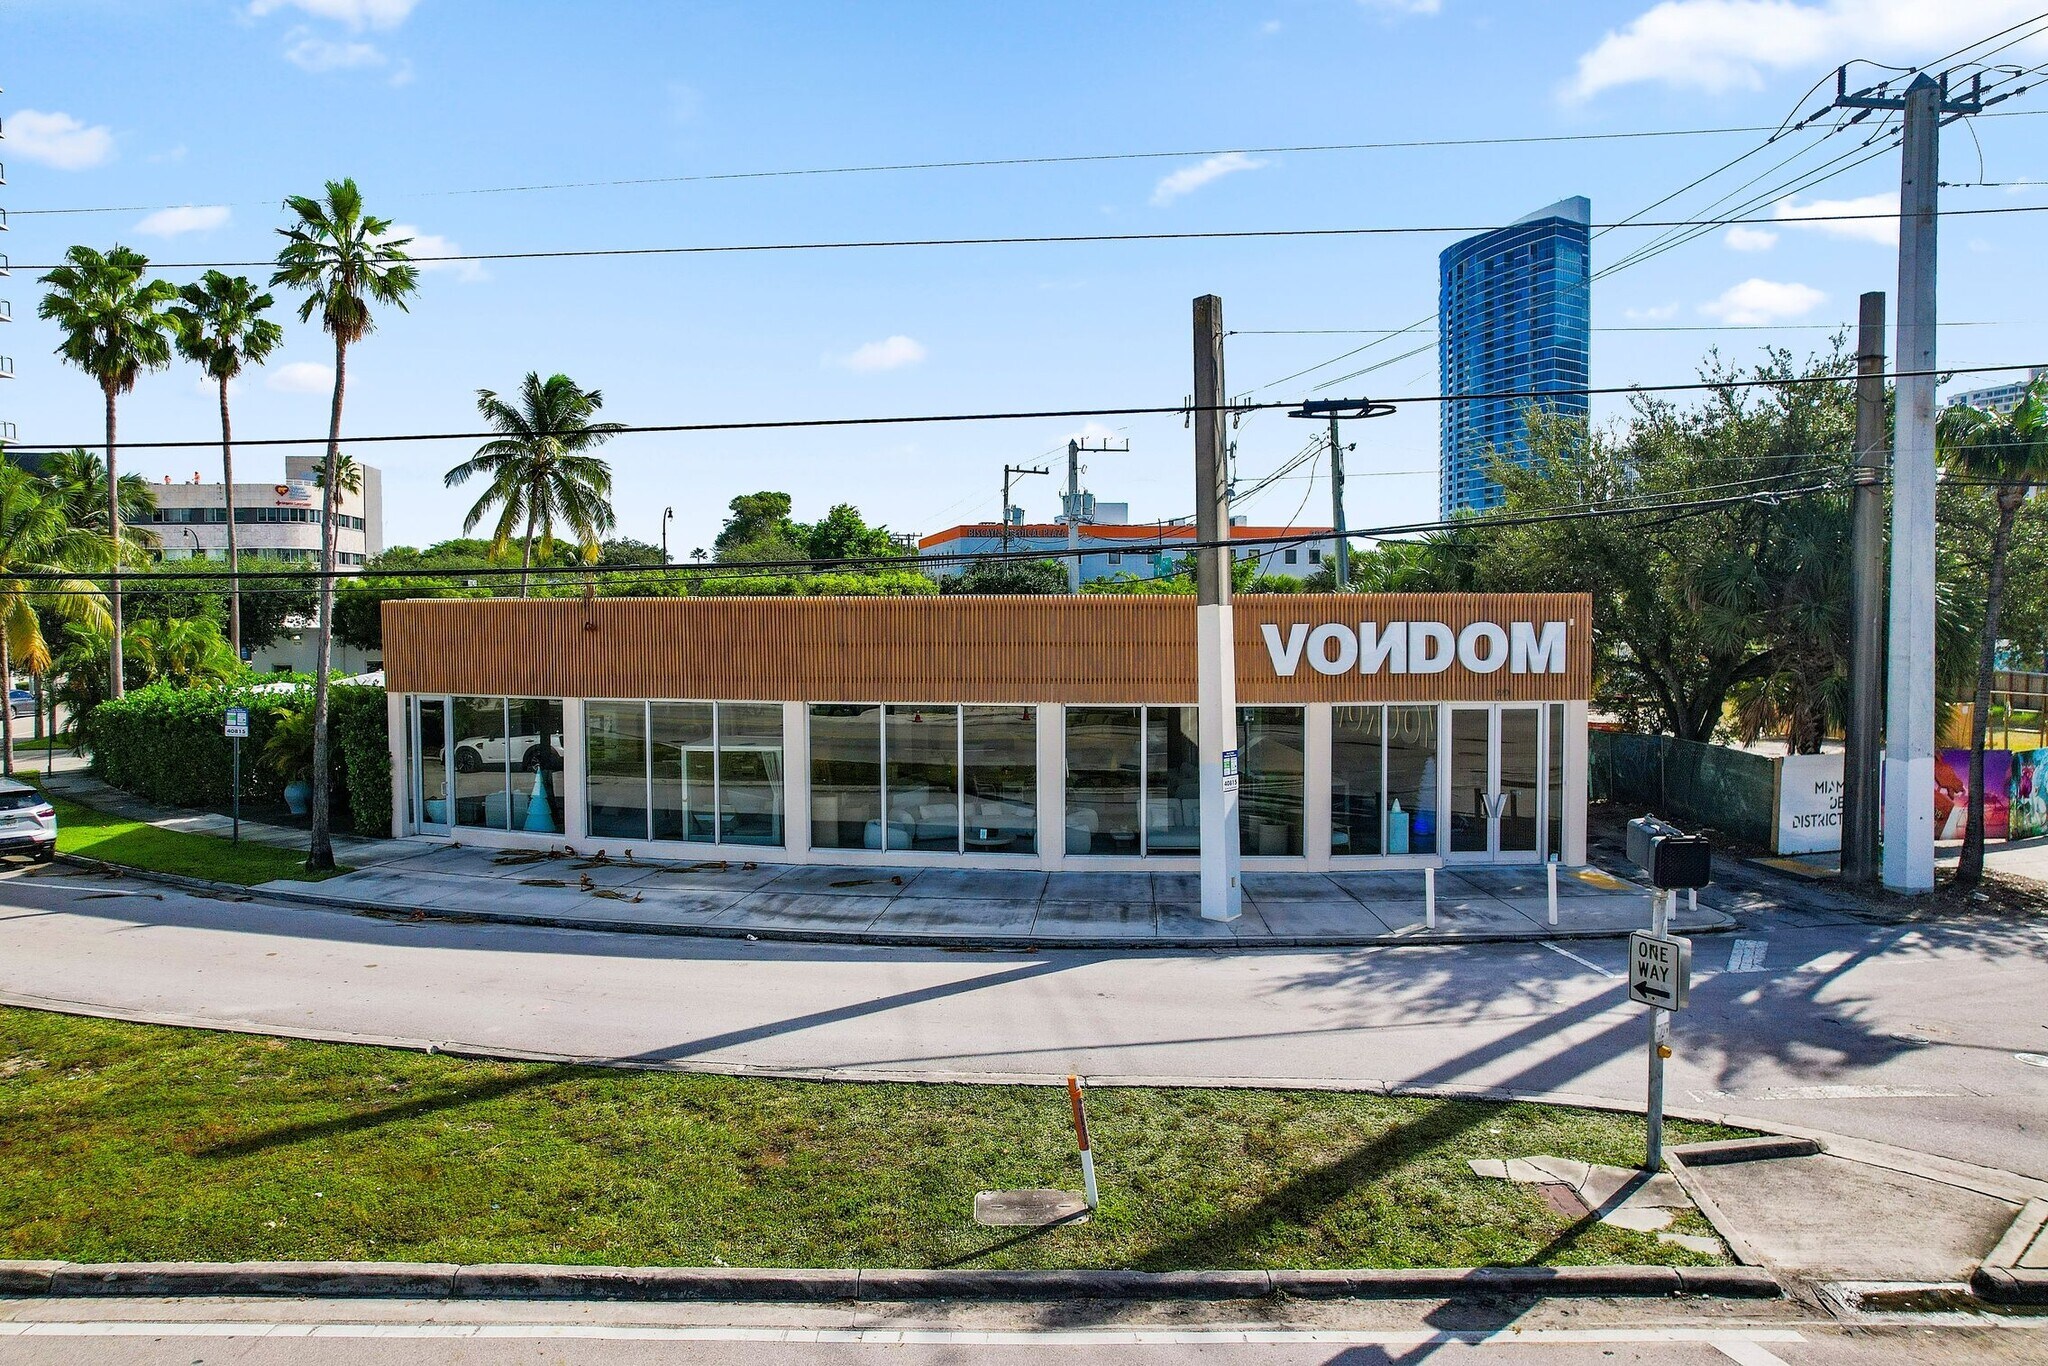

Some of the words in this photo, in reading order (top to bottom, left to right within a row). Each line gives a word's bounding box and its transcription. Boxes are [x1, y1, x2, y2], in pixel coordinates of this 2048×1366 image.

[1815, 780, 1845, 795] MIAM
[1638, 941, 1669, 963] ONE
[1638, 960, 1669, 982] WAY
